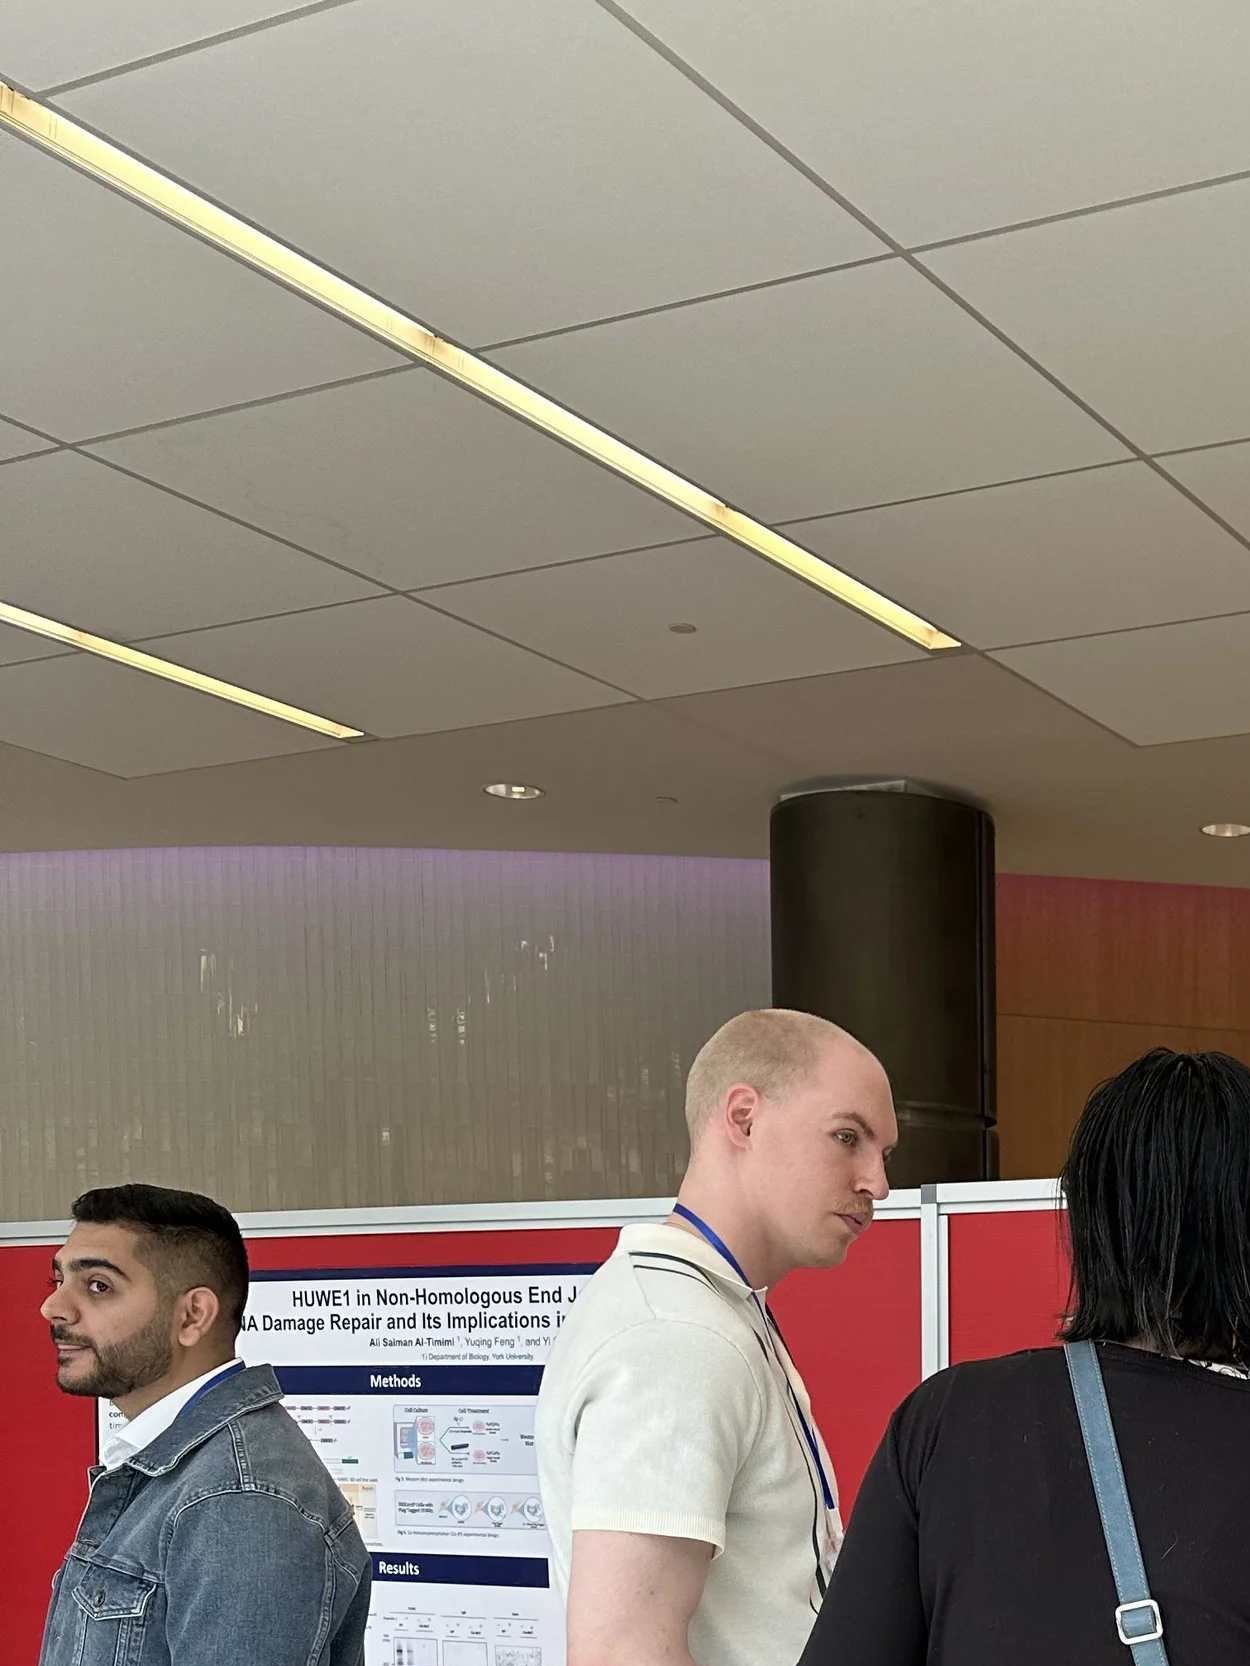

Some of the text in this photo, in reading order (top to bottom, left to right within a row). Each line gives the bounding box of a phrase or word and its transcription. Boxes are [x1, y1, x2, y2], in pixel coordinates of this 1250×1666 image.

[292, 1290, 350, 1307] HUWE1
[356, 1289, 371, 1306] in
[376, 1287, 523, 1309] Non-Homologous
[528, 1286, 562, 1304] End
[262, 1314, 325, 1335] Damage
[330, 1313, 382, 1334] Repair
[387, 1312, 417, 1330] and
[422, 1312, 442, 1329] Its
[447, 1311, 551, 1333] Implications
[382, 1337, 413, 1347] Salman
[414, 1337, 455, 1347] Al-Timimi
[464, 1337, 493, 1349] Yuqing
[494, 1336, 515, 1349] Feng
[525, 1337, 541, 1346] and
[428, 1353, 461, 1362] Department
[462, 1353, 468, 1361] of
[491, 1352, 505, 1361] York
[370, 1374, 422, 1388] Methods
[378, 1561, 420, 1576] Results
